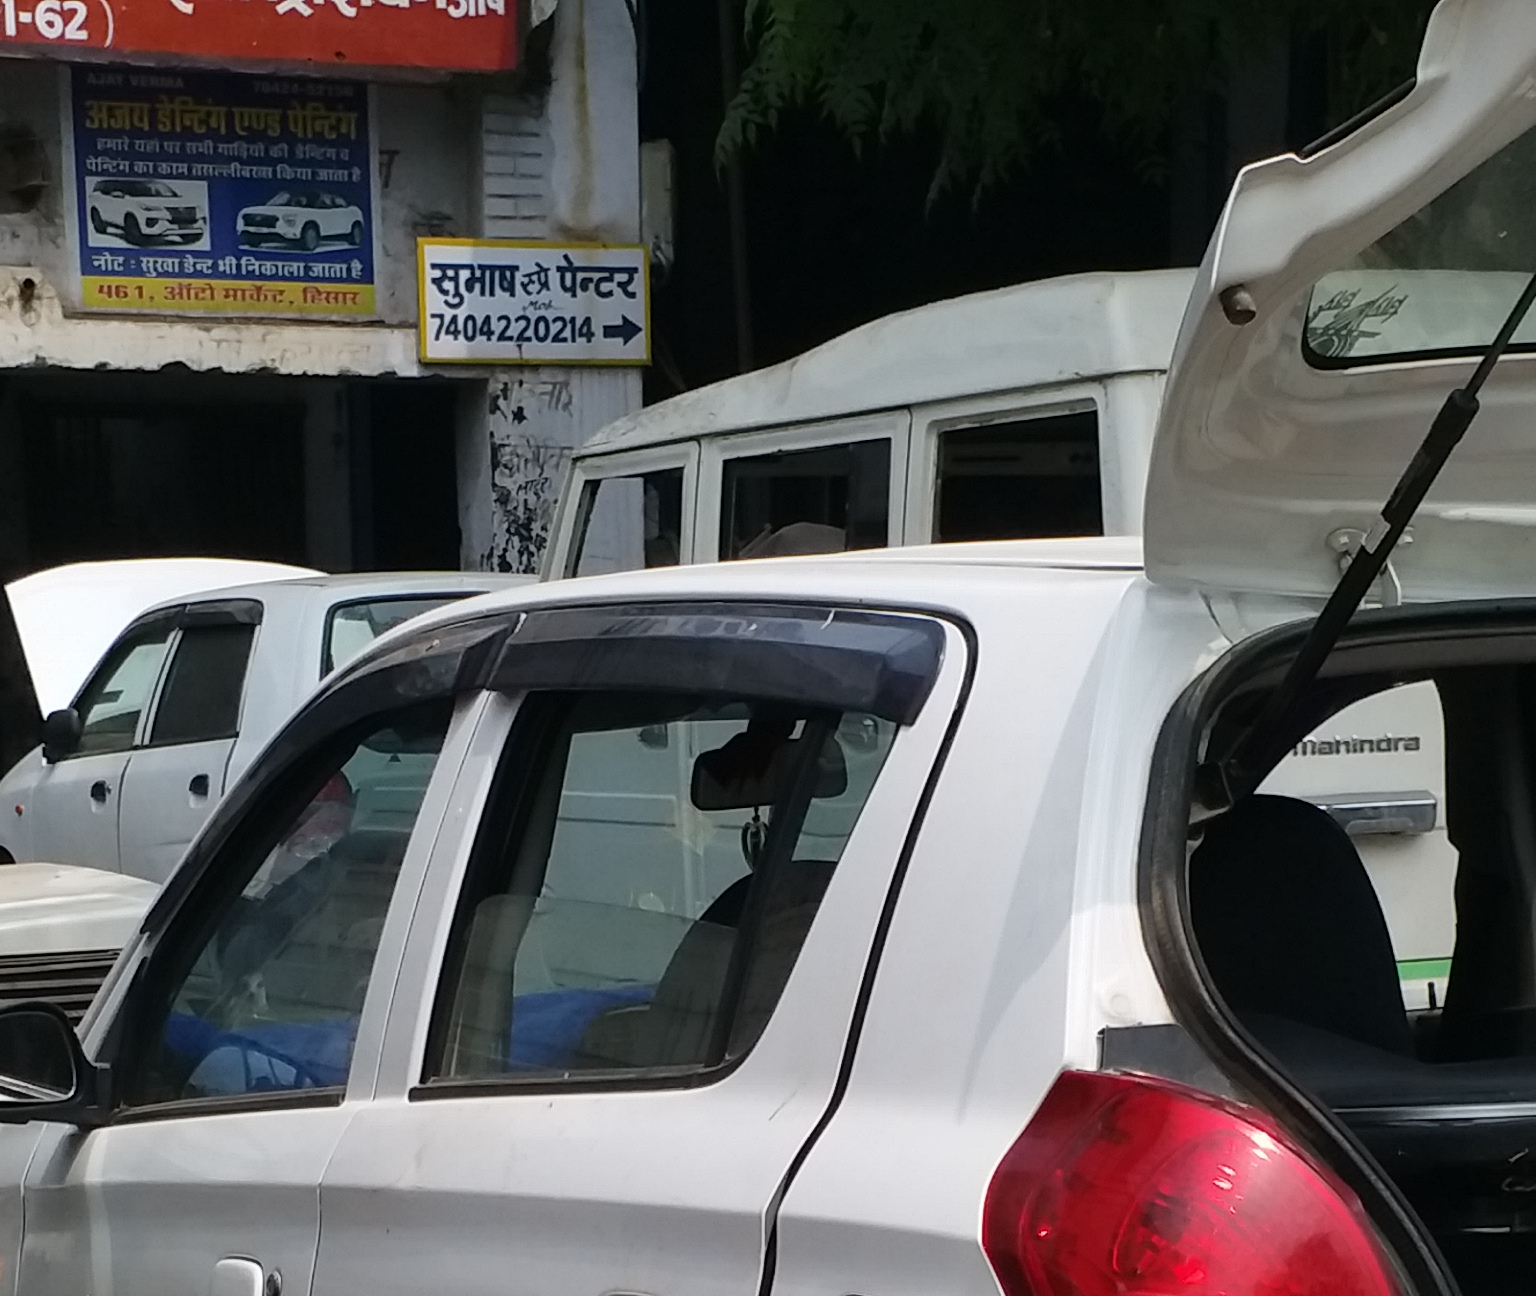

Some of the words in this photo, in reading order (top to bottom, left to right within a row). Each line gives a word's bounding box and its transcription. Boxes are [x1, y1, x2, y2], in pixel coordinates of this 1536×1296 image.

[85, 101, 150, 131] अजय
[156, 94, 227, 135] डेन्टिंग
[232, 107, 282, 137] एण्ड
[286, 99, 357, 140] पेन्टिंग
[97, 136, 130, 152] हमारे
[164, 139, 181, 154] पर
[185, 138, 214, 156] सभी
[85, 155, 130, 175] पेन्टिंग
[133, 159, 154, 175] का
[156, 160, 189, 177] काम
[276, 162, 312, 182] किया
[315, 167, 350, 183] जाता
[352, 165, 363, 184] है
[92, 252, 125, 272] नोट
[183, 253, 214, 275] डेन्ट
[217, 256, 237, 276] भी
[240, 256, 305, 278] निकाला
[308, 261, 348, 280] जाता
[350, 258, 363, 280] है
[302, 285, 362, 306] हिसार
[429, 263, 519, 310] सुभाष
[555, 253, 638, 299] पेन्टर
[430, 313, 595, 344] 7404220214
